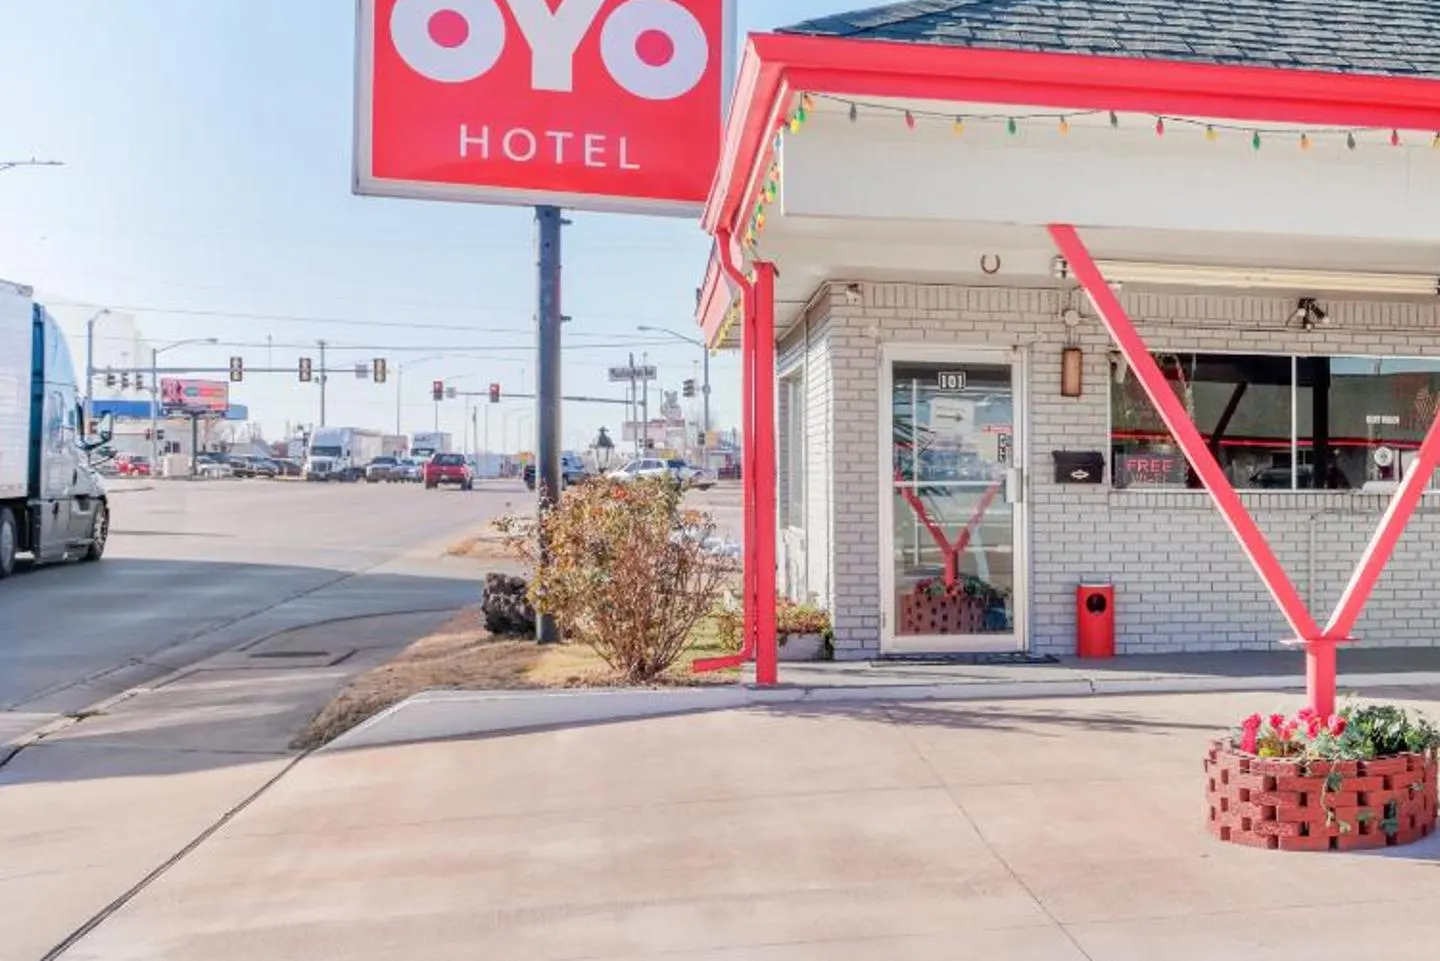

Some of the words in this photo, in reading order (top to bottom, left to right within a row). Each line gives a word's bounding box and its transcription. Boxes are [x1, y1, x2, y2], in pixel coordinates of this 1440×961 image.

[459, 124, 641, 169] HOTEL
[941, 375, 963, 388] 101
[1126, 458, 1174, 472] FREE
